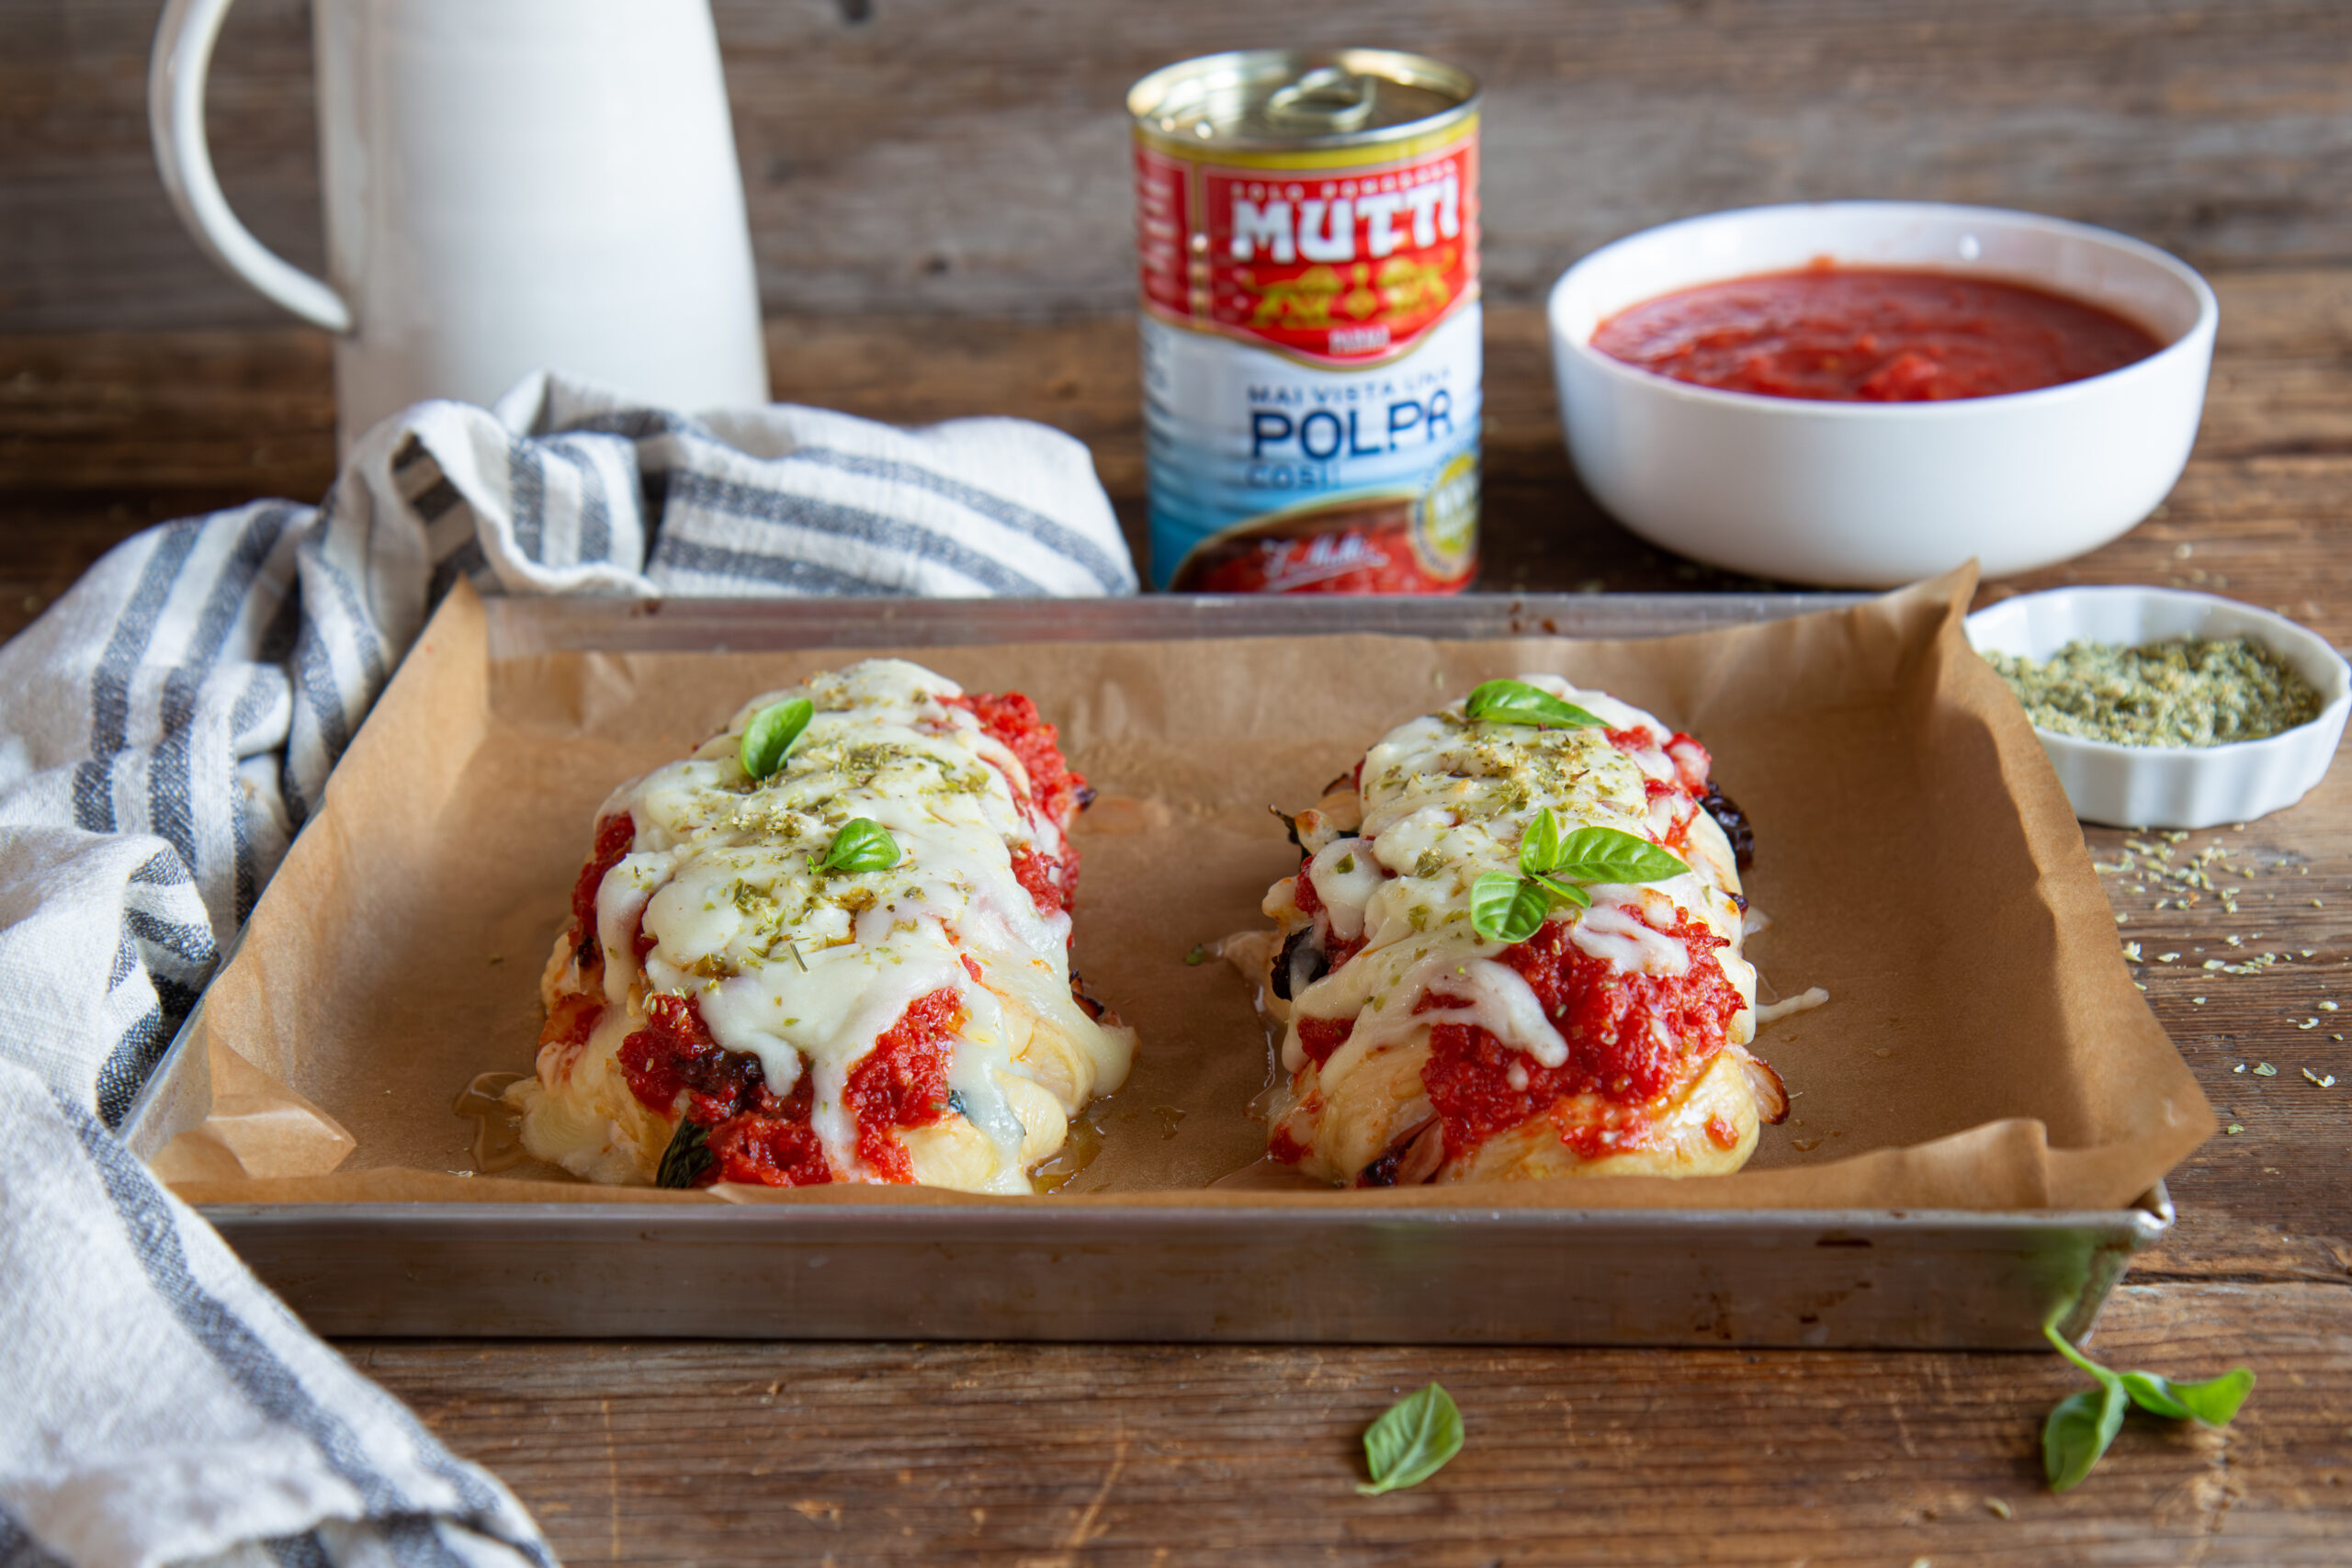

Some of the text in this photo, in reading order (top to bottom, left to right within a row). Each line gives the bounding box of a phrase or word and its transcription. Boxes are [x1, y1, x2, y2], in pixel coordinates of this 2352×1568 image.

[1231, 175, 1459, 264] MUTTI
[1249, 385, 1303, 405] MAI
[1311, 382, 1395, 404] VISTA
[1250, 389, 1454, 460] POLPA
